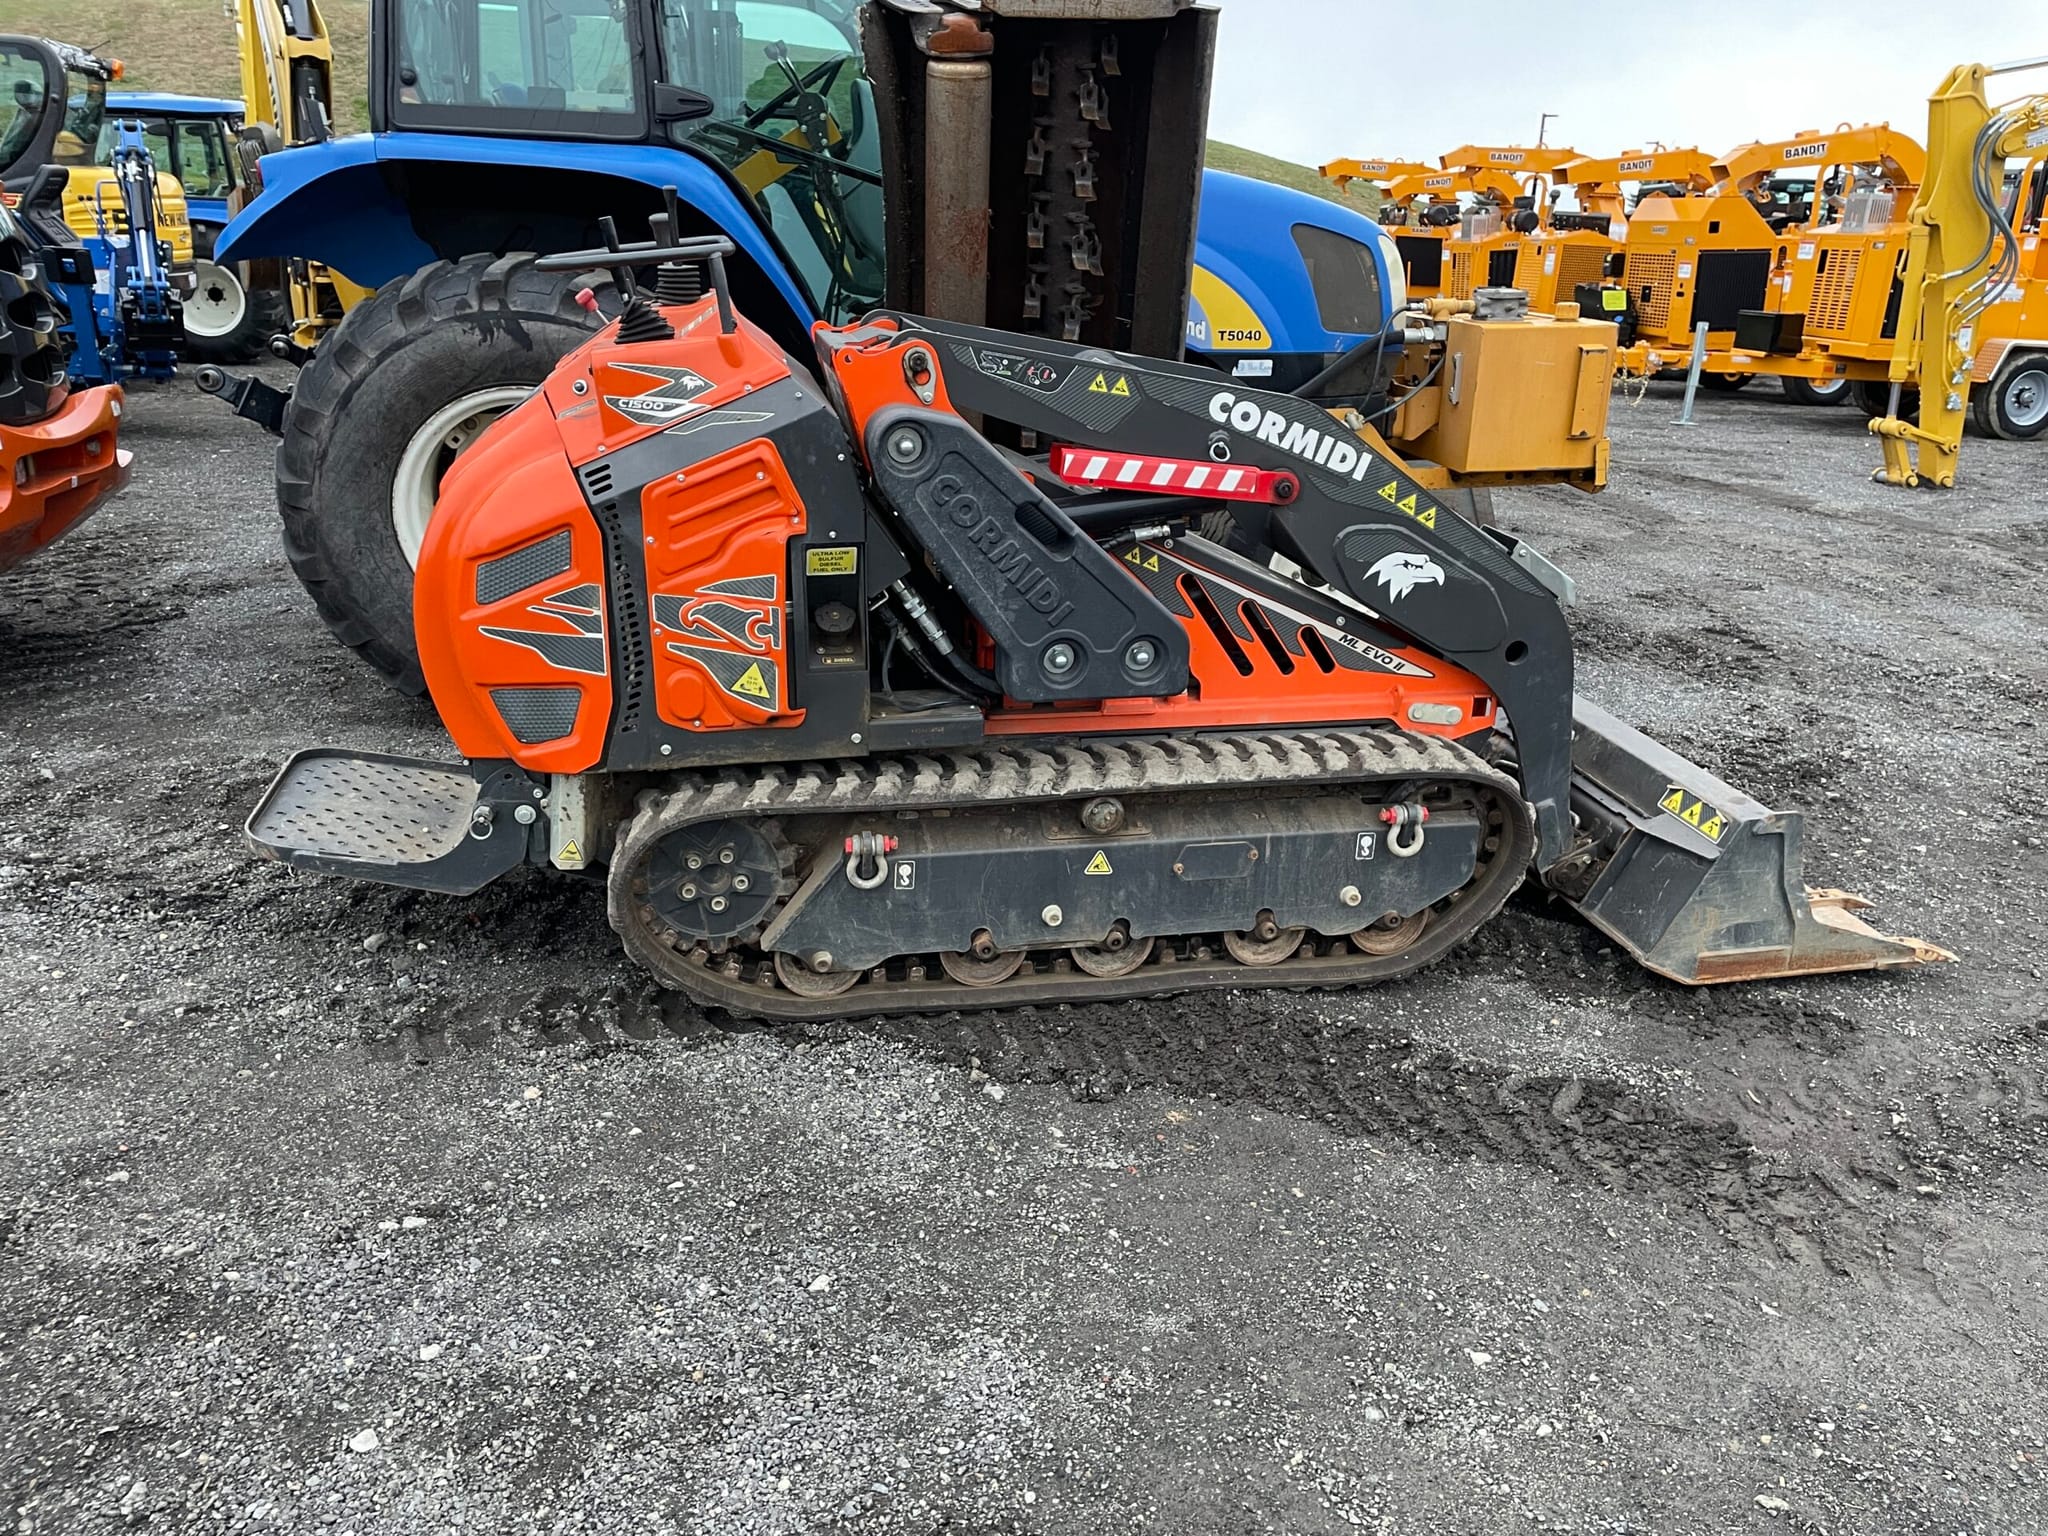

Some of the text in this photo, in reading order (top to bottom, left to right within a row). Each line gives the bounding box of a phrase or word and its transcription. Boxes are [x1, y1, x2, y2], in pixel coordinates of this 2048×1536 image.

[1785, 143, 1827, 159] BANDIT
[1490, 153, 1523, 162] BANDIT
[1361, 164, 1387, 172] BANDIT
[1619, 160, 1653, 172] BANDIT
[1425, 178, 1452, 187] BANDIT
[1218, 330, 1262, 342] T5040
[618, 399, 664, 411] C1500
[1208, 392, 1373, 482] CORMIDI
[930, 474, 1075, 628] CORMIDI
[1338, 634, 1361, 650] ML
[1362, 645, 1394, 666] EVO
